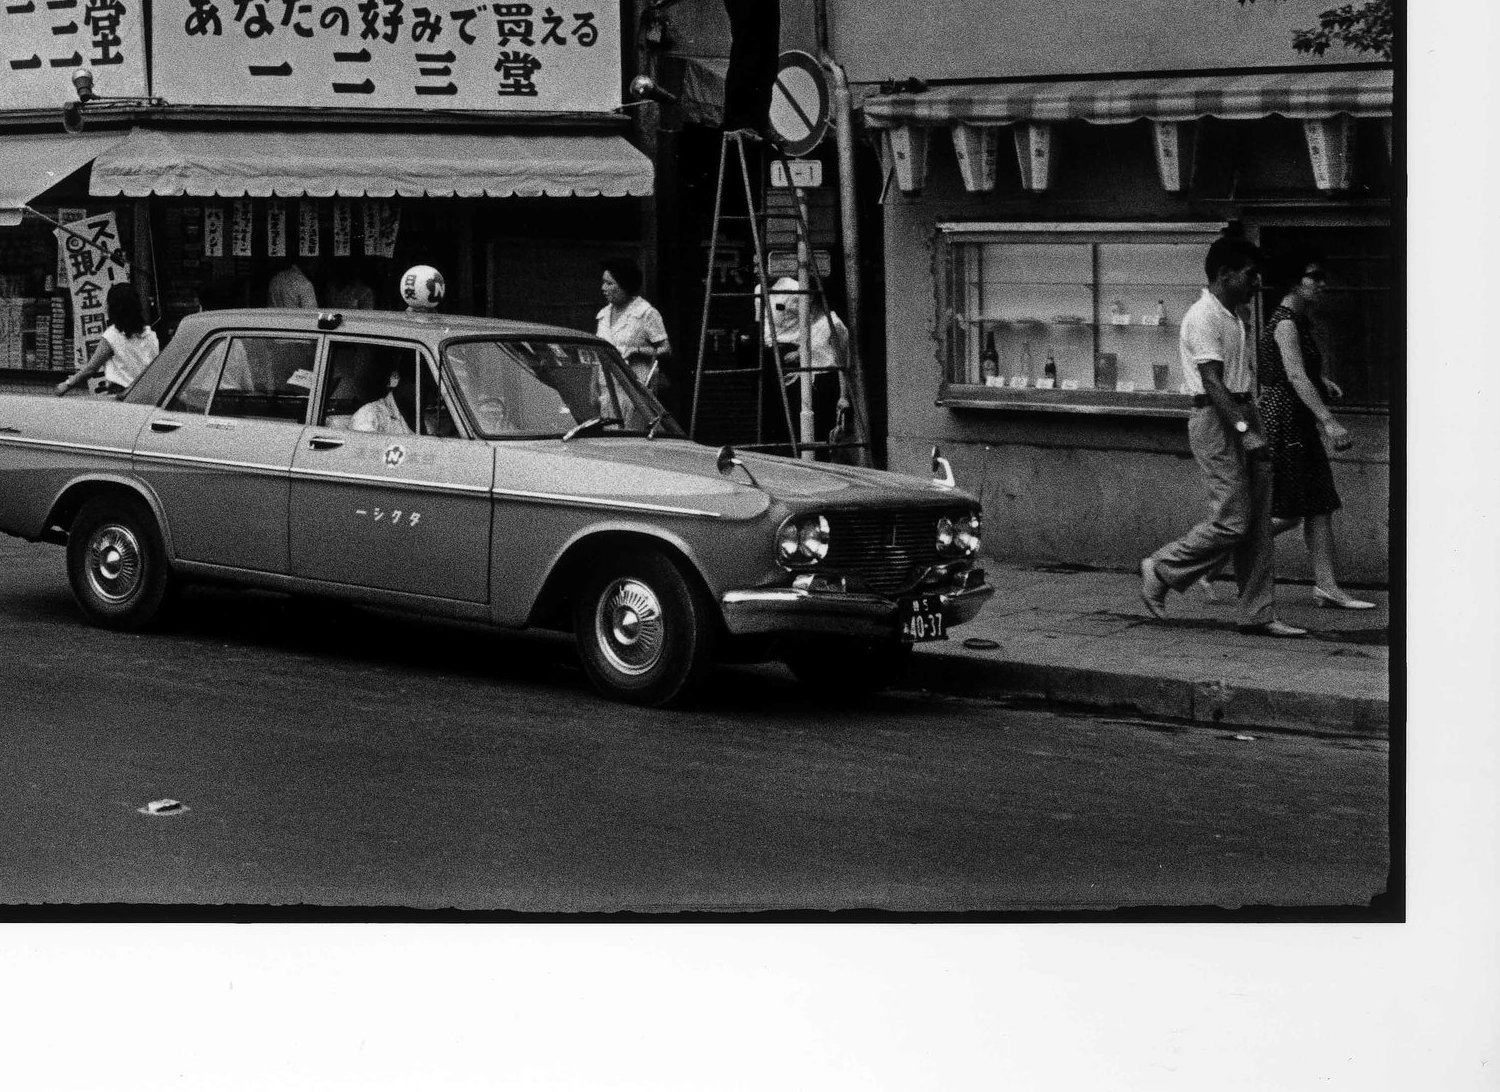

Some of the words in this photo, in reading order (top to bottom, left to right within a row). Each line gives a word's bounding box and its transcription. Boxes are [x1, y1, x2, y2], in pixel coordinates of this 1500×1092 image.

[248, 48, 542, 97] 一二三堂
[68, 250, 107, 358] 現金問
